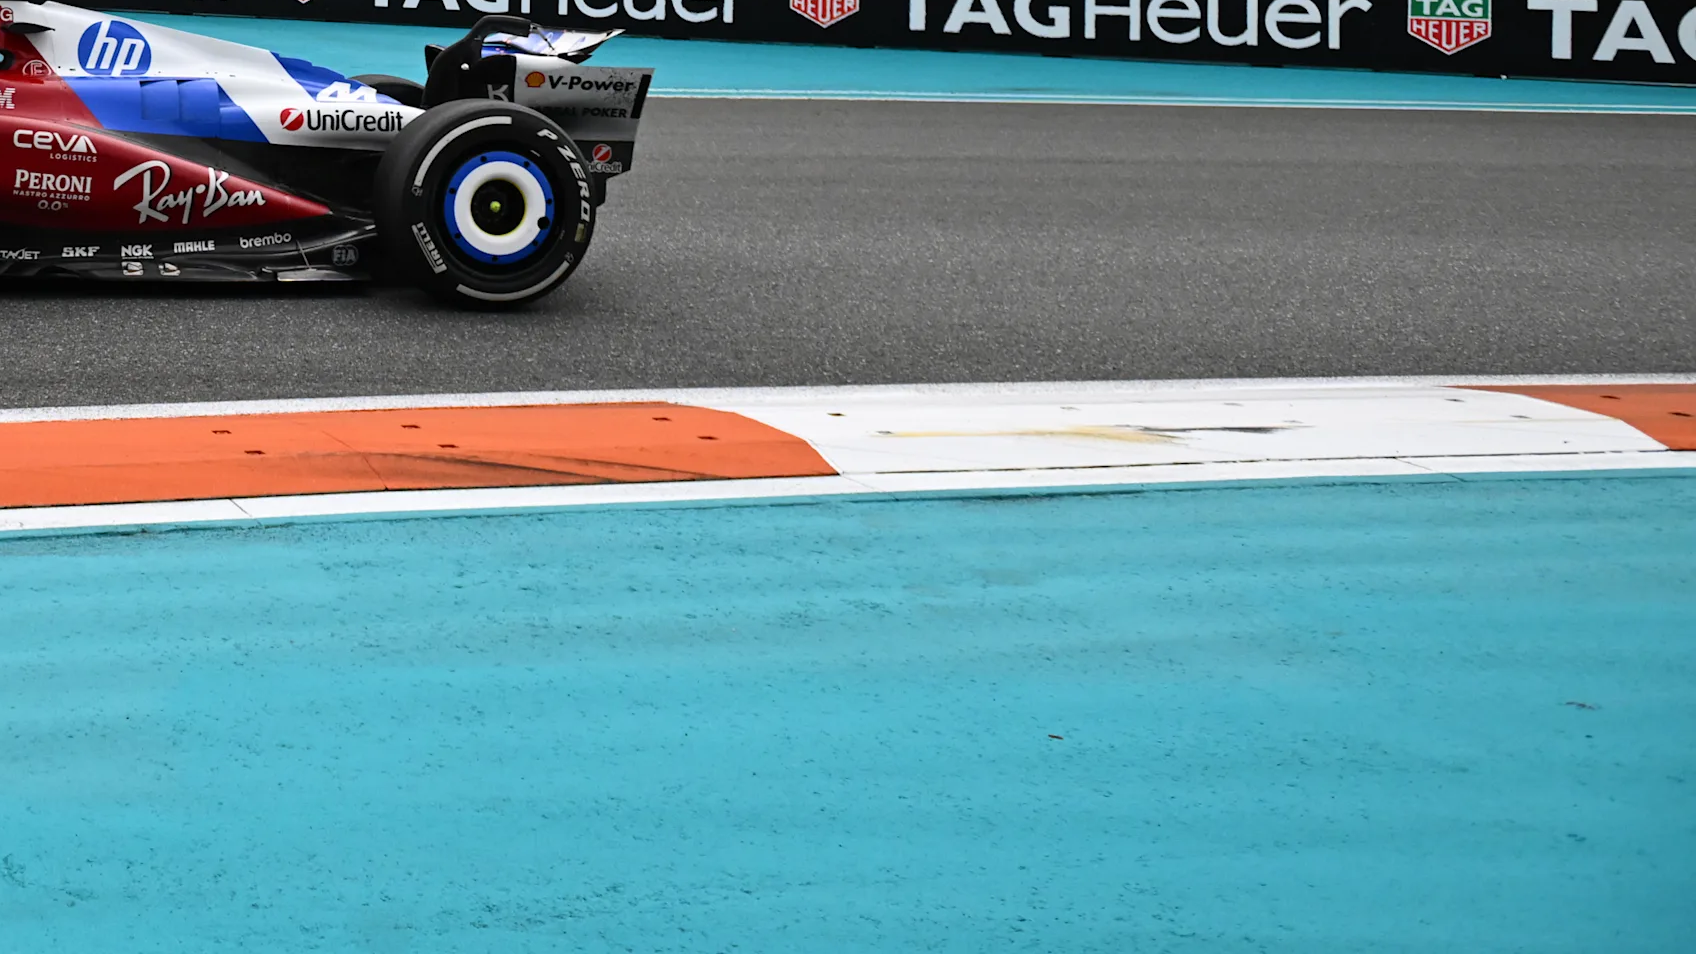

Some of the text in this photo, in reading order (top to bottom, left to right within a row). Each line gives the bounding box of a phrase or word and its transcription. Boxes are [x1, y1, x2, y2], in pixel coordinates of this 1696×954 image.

[1412, 19, 1486, 49] HEUER
[85, 20, 145, 77] hp
[316, 81, 377, 103] 44
[548, 75, 634, 92] V-Power
[307, 109, 403, 132] UniCredit
[582, 107, 627, 119] POKER
[50, 153, 98, 163] LOGISTICS
[14, 168, 92, 194] PERONI
[537, 128, 590, 222] P ZERO
[13, 189, 90, 201] NASTRO AZZURRO
[174, 240, 215, 254] MAHLE
[239, 232, 292, 249] brembo
[411, 221, 447, 274] PIRELLI
[62, 246, 100, 257] SKF
[121, 243, 153, 257] NGK
